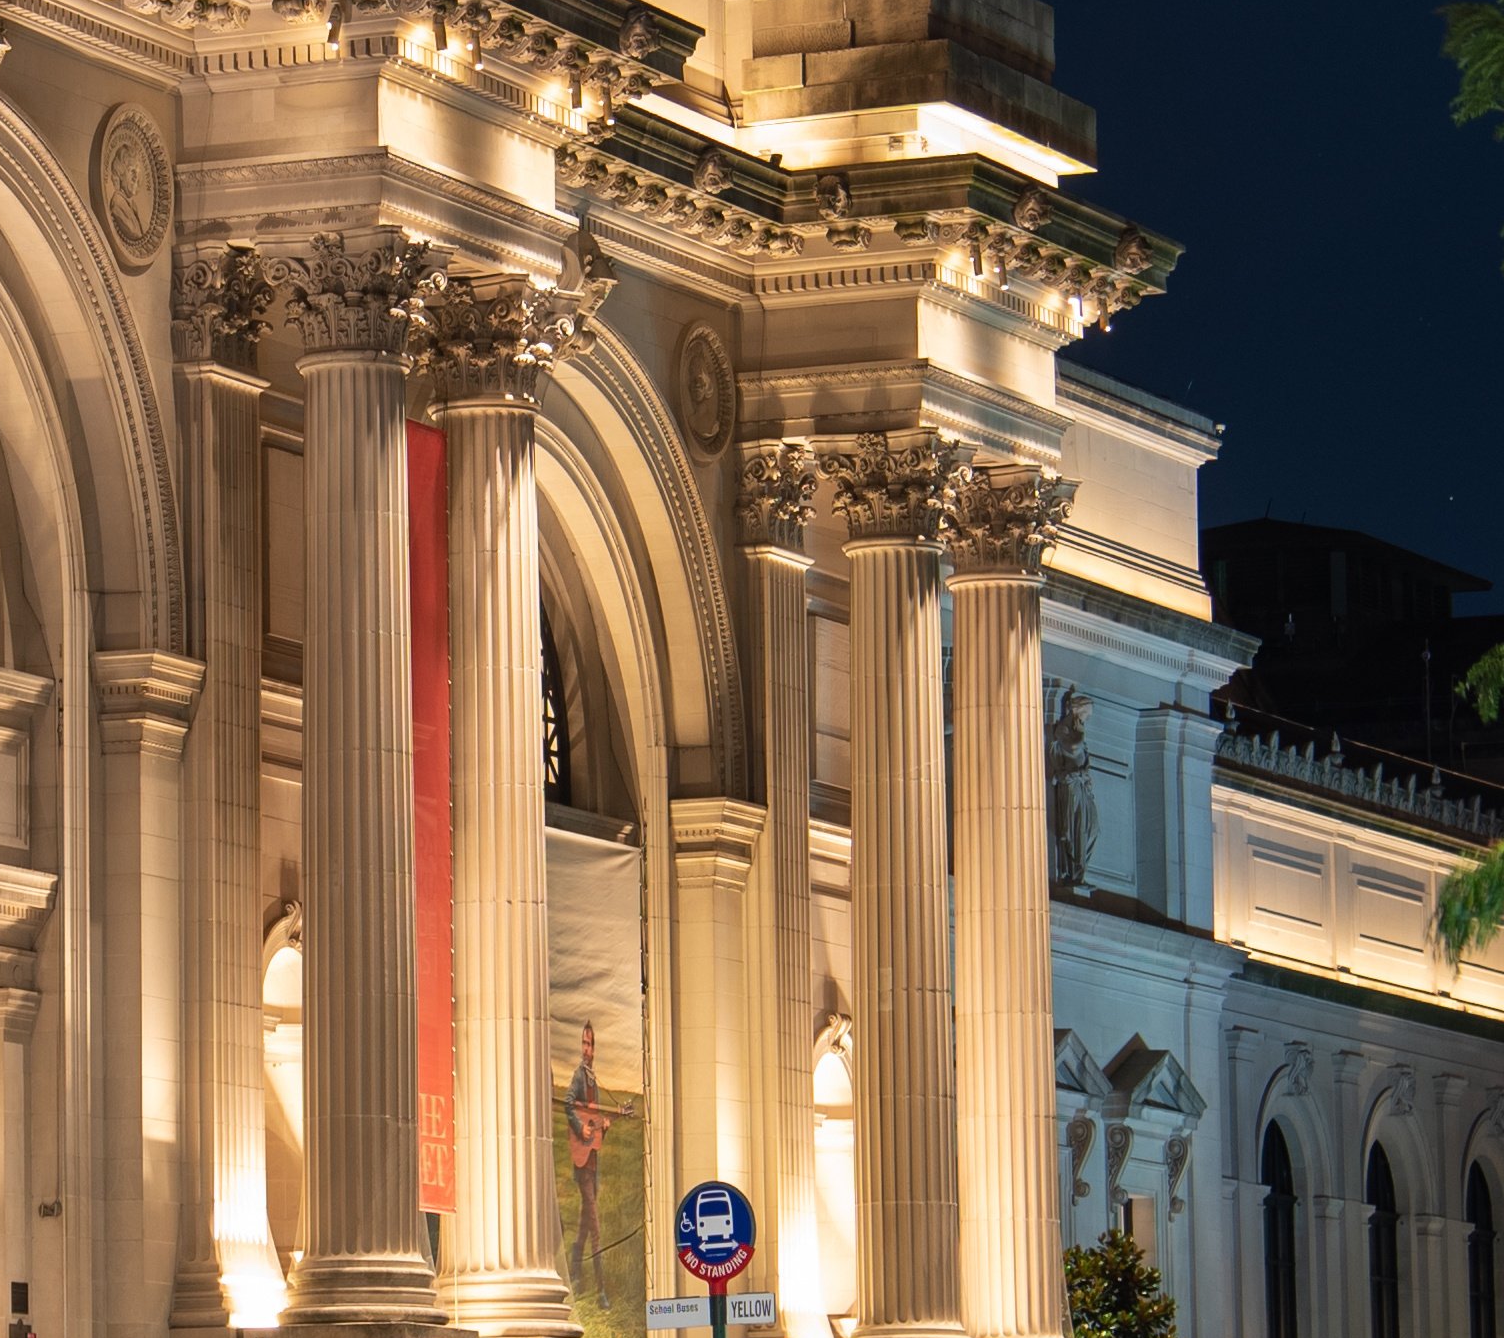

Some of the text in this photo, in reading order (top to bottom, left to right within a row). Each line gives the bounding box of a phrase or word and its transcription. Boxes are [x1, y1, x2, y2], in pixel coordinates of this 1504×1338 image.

[418, 1092, 446, 1139] HE
[421, 1142, 449, 1187] ET
[684, 1249, 748, 1278] NO STANDING
[649, 1303, 699, 1315] School Buses
[731, 1299, 772, 1318] YELLOW
